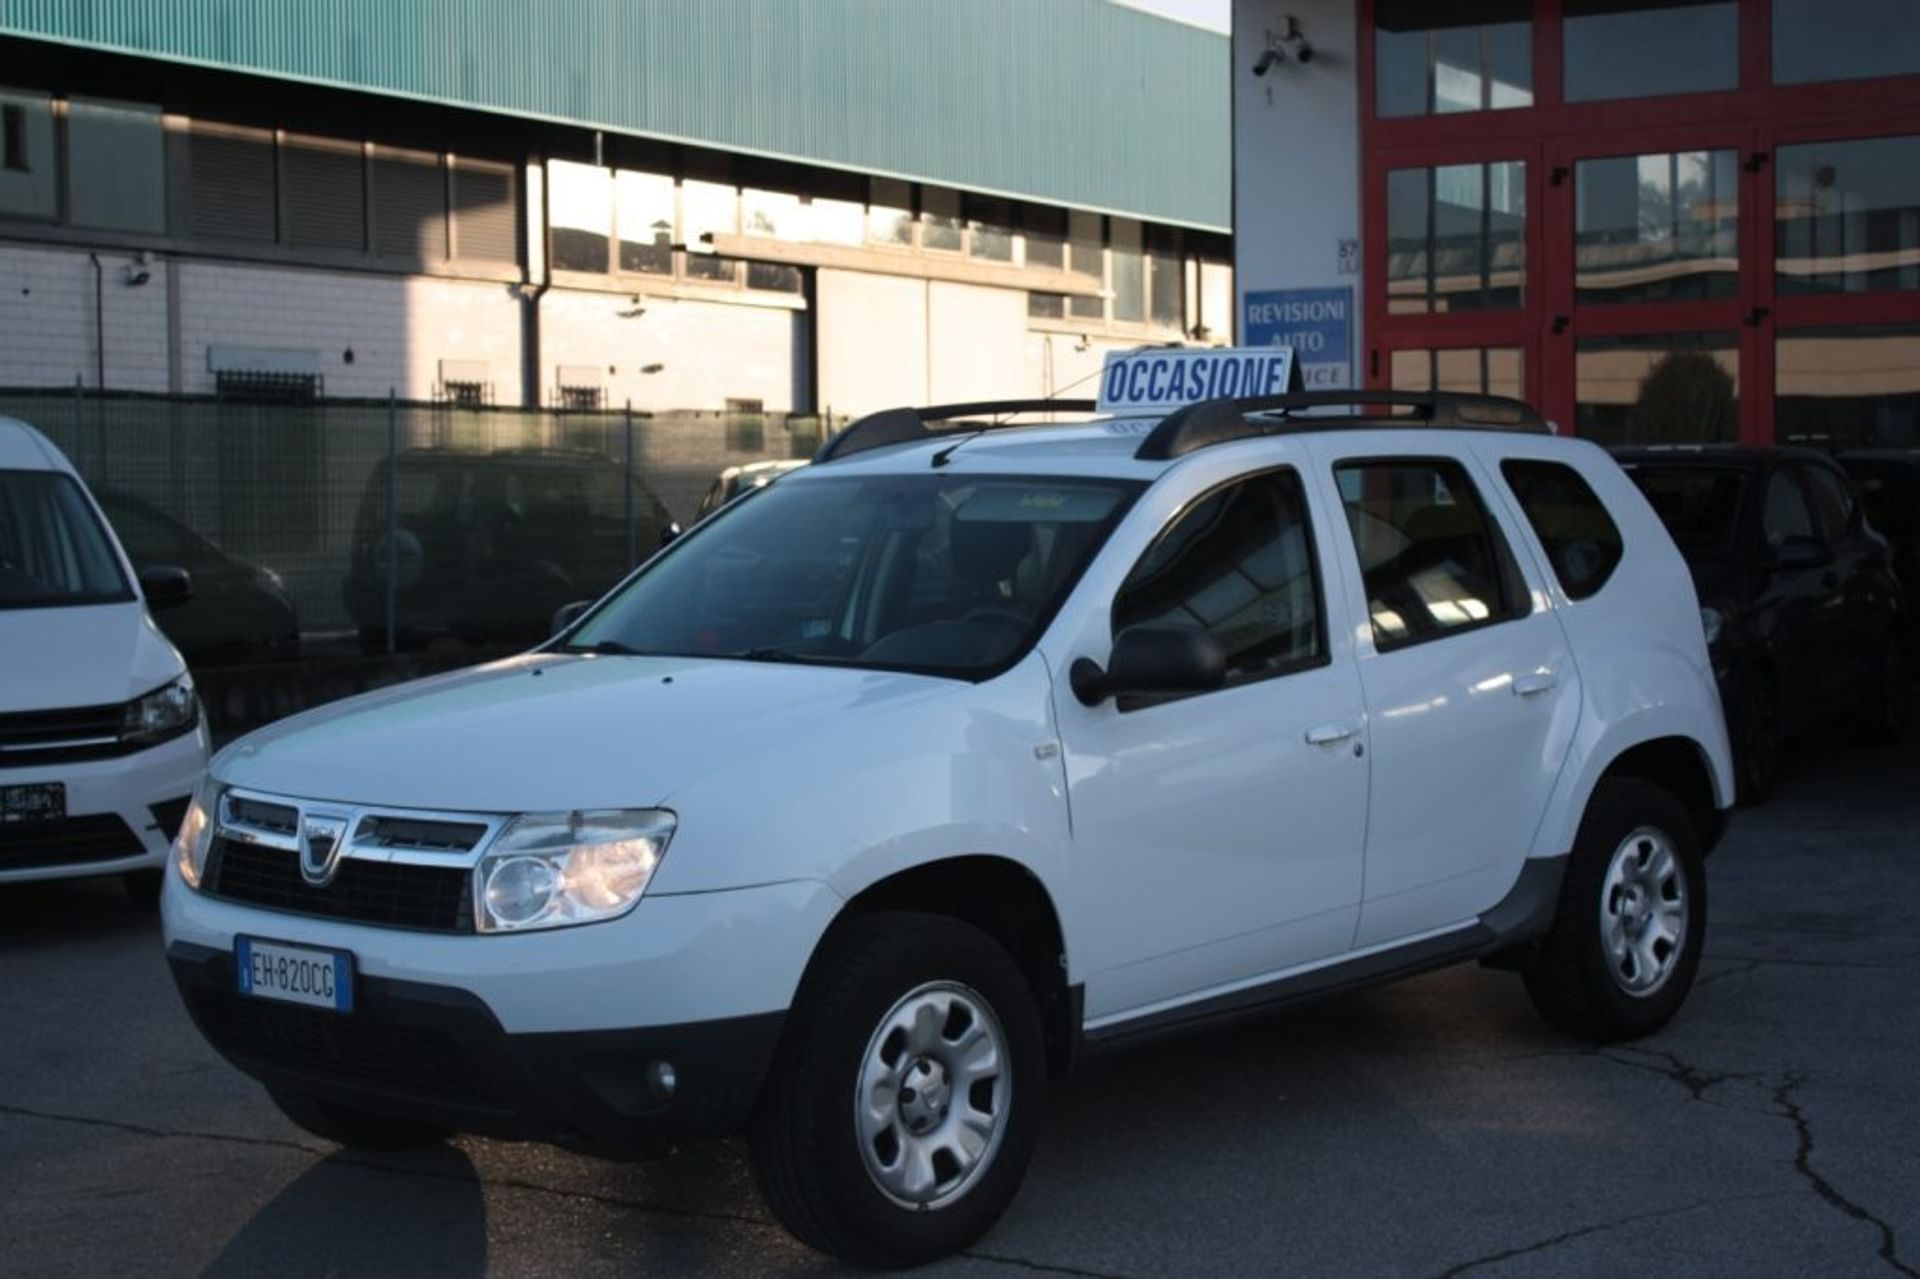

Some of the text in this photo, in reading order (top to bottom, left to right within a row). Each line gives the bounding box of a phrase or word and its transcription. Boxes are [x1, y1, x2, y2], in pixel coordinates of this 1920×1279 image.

[1248, 300, 1345, 325] REVISIONI
[1271, 331, 1324, 352] AUTO
[1107, 357, 1283, 403] OCCASIONE
